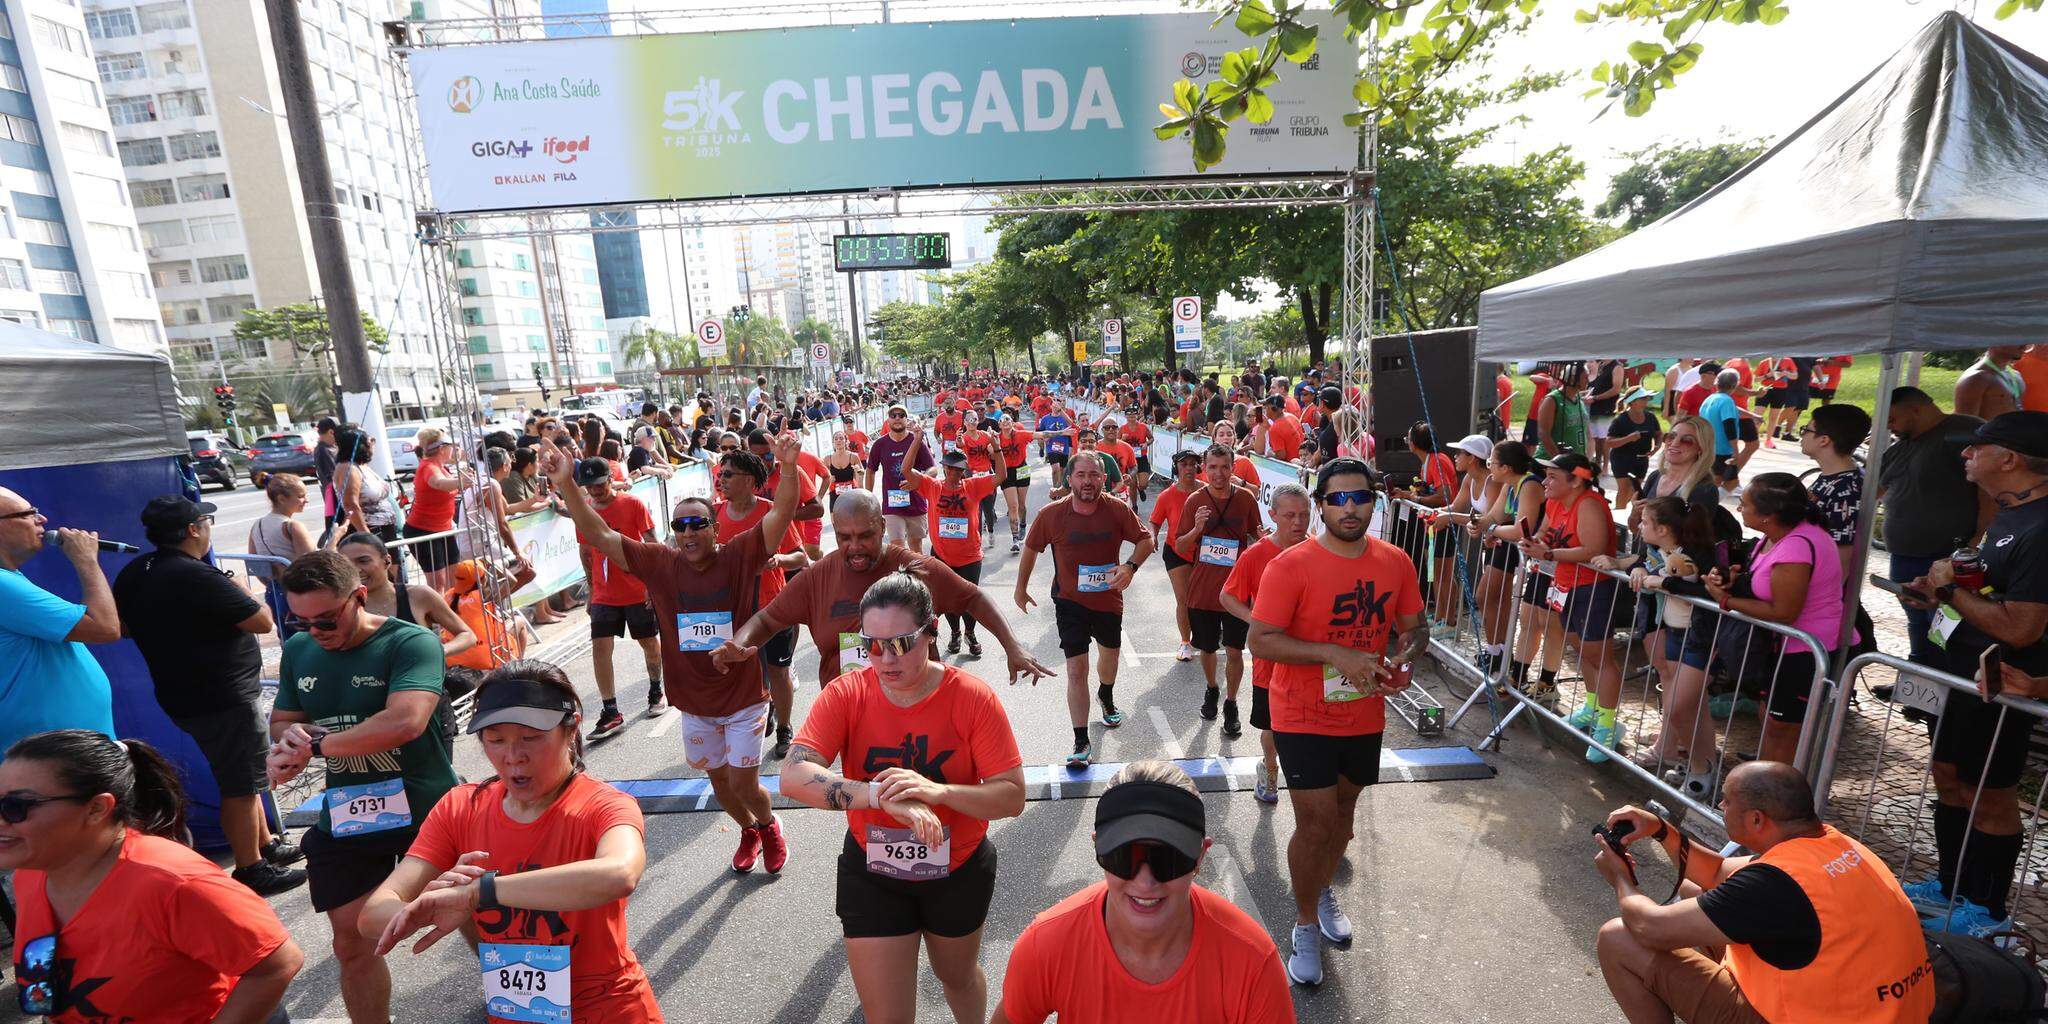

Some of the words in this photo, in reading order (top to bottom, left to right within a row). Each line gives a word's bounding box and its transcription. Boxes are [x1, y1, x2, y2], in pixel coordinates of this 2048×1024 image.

[493, 82, 519, 102] Ana
[522, 80, 557, 99] Costa
[560, 77, 600, 98] Saúde
[763, 66, 1124, 144] CHEGADA
[1289, 116, 1319, 126] GRUPO
[1249, 128, 1279, 136] TRIBUNA
[1289, 127, 1328, 136] TRIBUNA
[662, 132, 751, 148] TRIBUNA
[695, 147, 721, 158] 2025
[504, 174, 545, 184] KALLAN
[553, 172, 577, 182] FILA
[839, 234, 944, 262] 00:53:00
[1183, 303, 1191, 316] E
[706, 326, 715, 339] E
[1109, 323, 1115, 332] E
[817, 347, 823, 356] E
[1209, 546, 1229, 555] 7200
[1088, 574, 1106, 582] 7143
[1328, 577, 1392, 626] 5K
[692, 625, 715, 636] 7181
[1351, 639, 1374, 648] 2025
[349, 797, 386, 815] 6737
[884, 844, 928, 860] 9638
[499, 969, 546, 991] 8473
